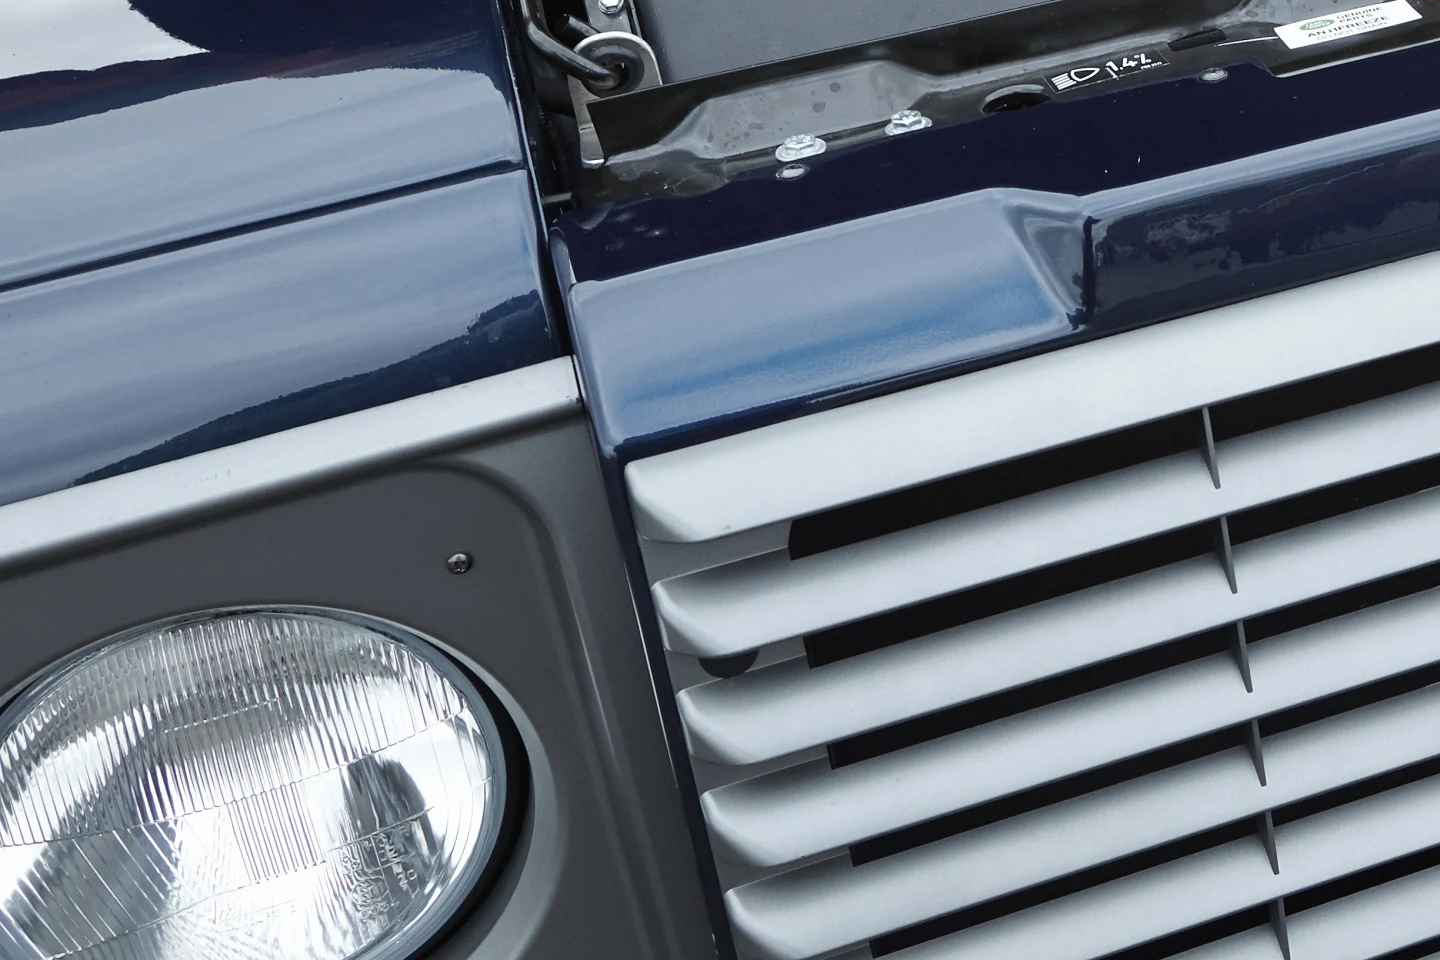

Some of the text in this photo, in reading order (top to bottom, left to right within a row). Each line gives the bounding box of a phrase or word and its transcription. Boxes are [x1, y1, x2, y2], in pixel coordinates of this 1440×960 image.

[1336, 6, 1383, 19] GENUINE
[1339, 13, 1374, 24] PARTS
[1308, 15, 1391, 38] ANTIFREEZE
